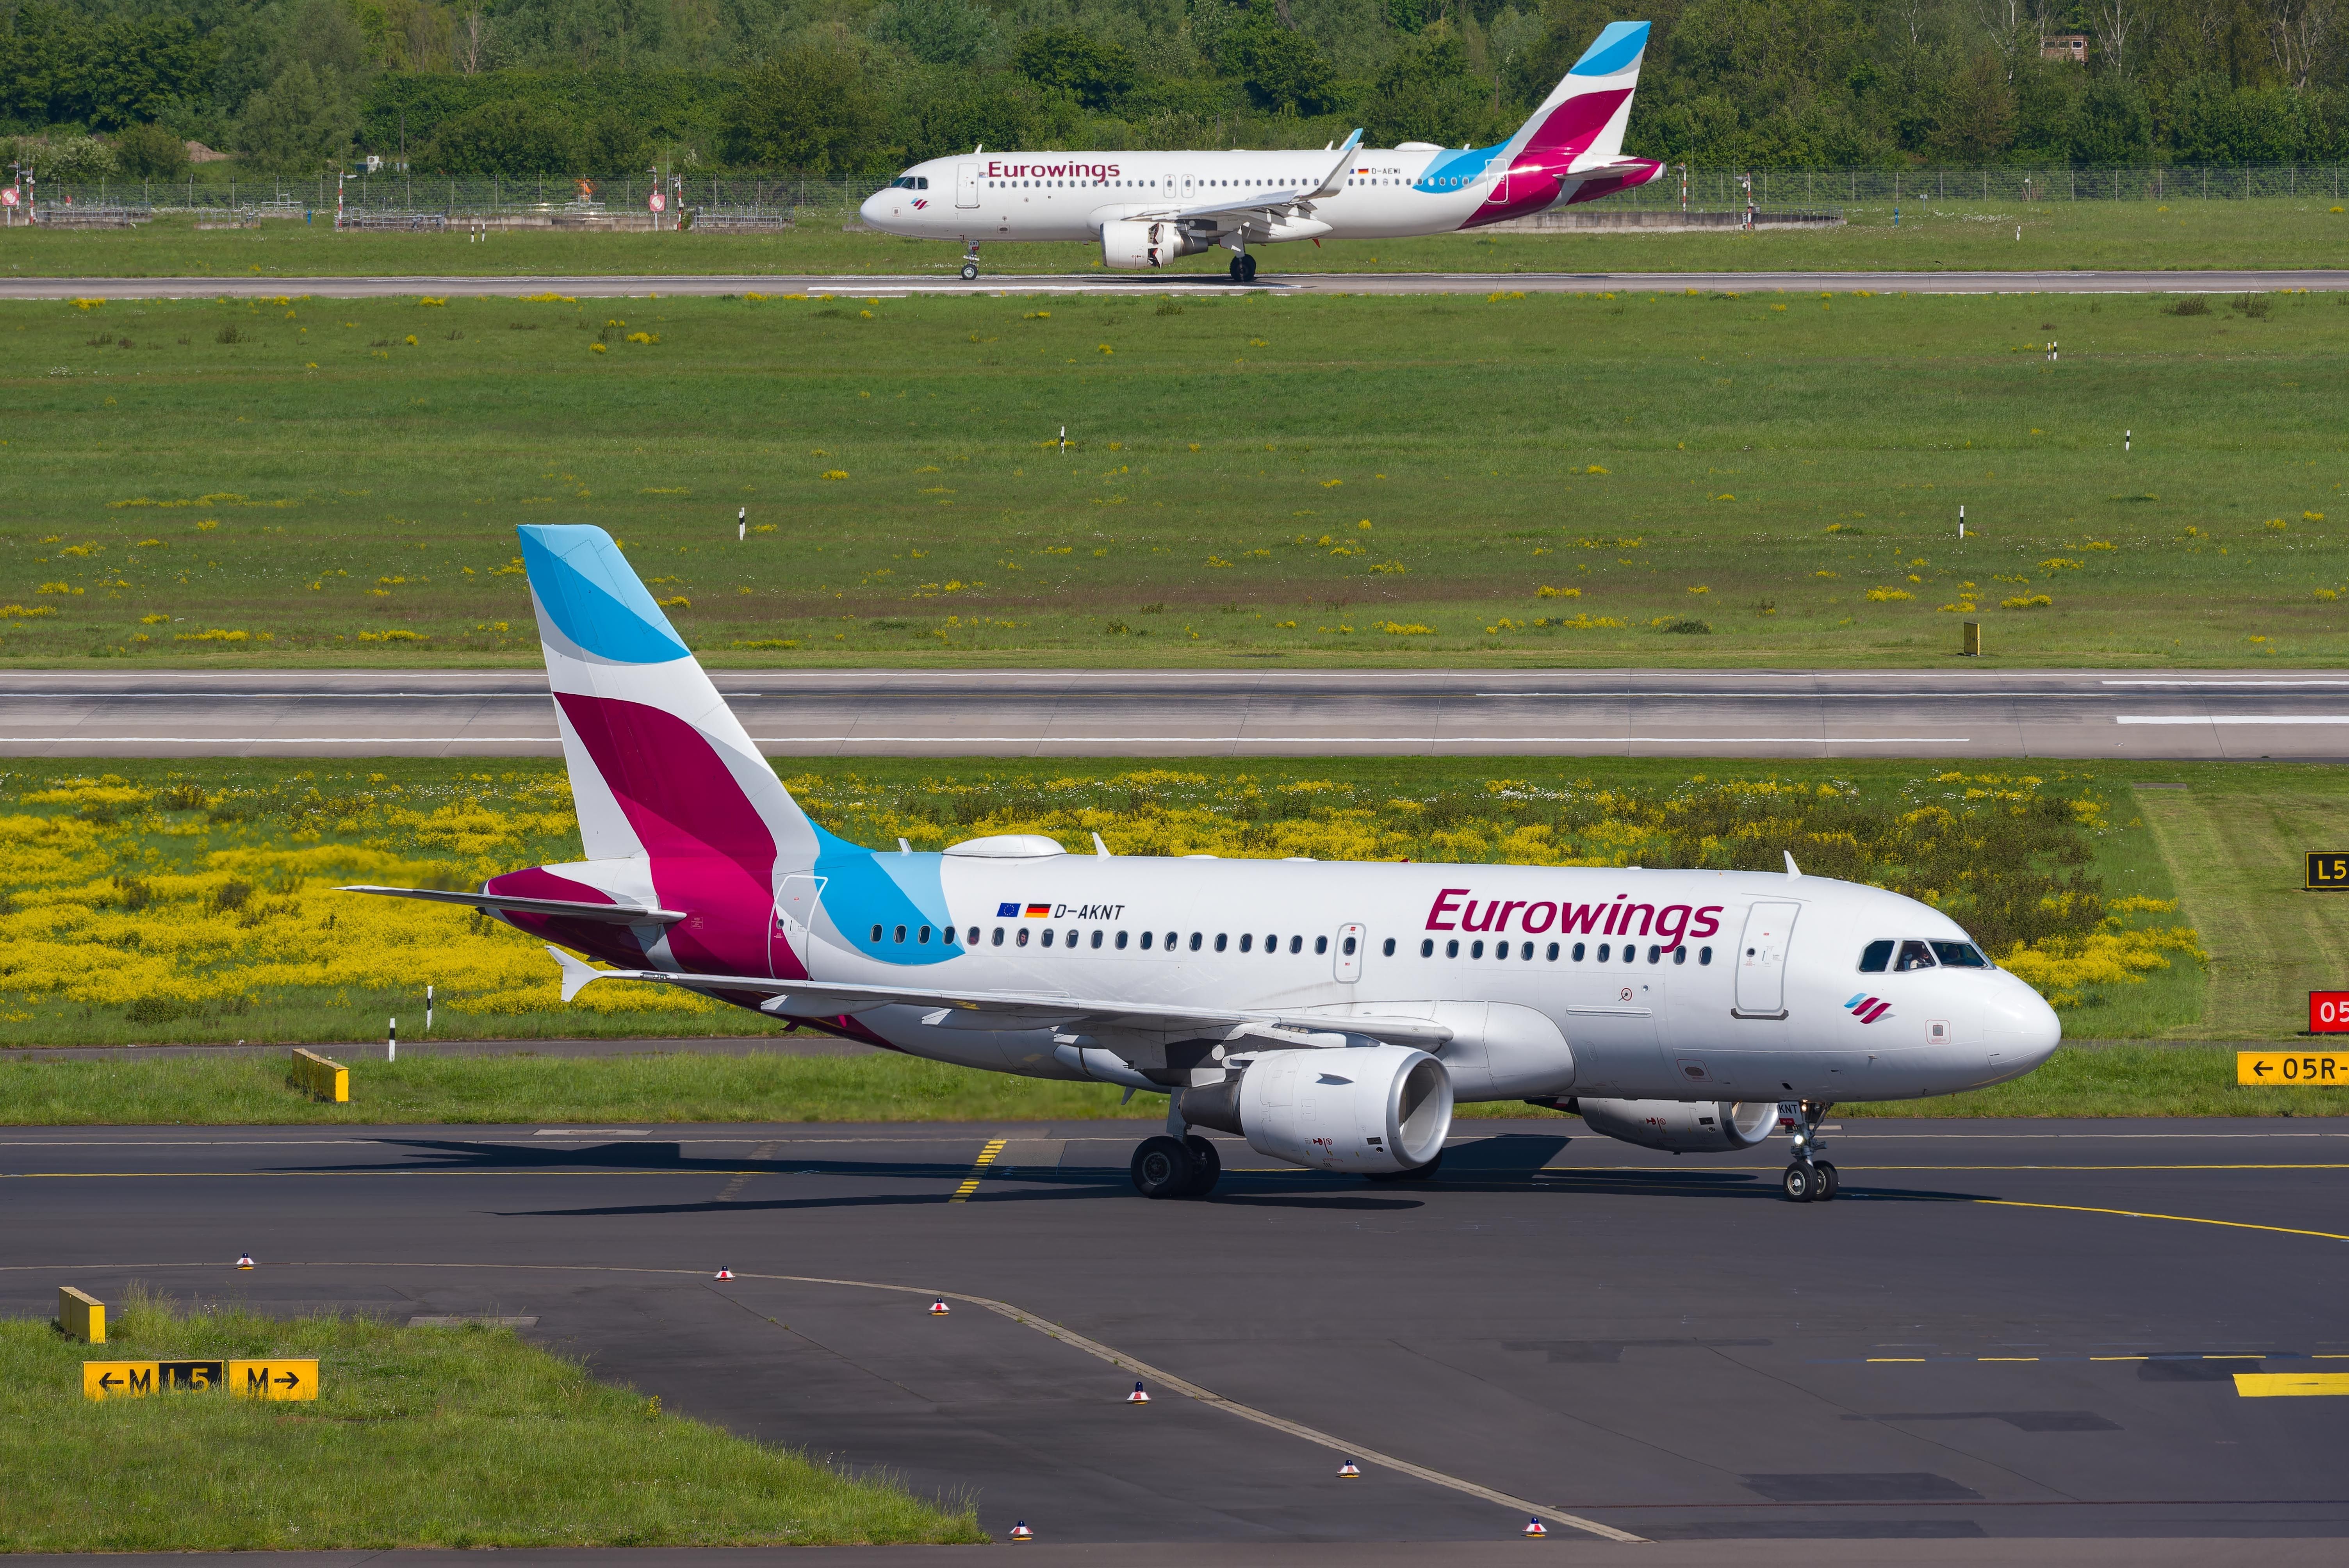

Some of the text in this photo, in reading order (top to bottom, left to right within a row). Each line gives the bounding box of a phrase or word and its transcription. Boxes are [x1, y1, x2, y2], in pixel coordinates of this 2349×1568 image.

[989, 161, 1120, 183] Eurowings
[2318, 860, 2347, 880] L5
[1054, 904, 1125, 920] D-AKNT
[1425, 889, 1724, 953] Eurowings
[2320, 1001, 2349, 1022] 05
[1779, 1104, 1797, 1114] KNT
[130, 1369, 150, 1394] M
[248, 1368, 268, 1394] M
